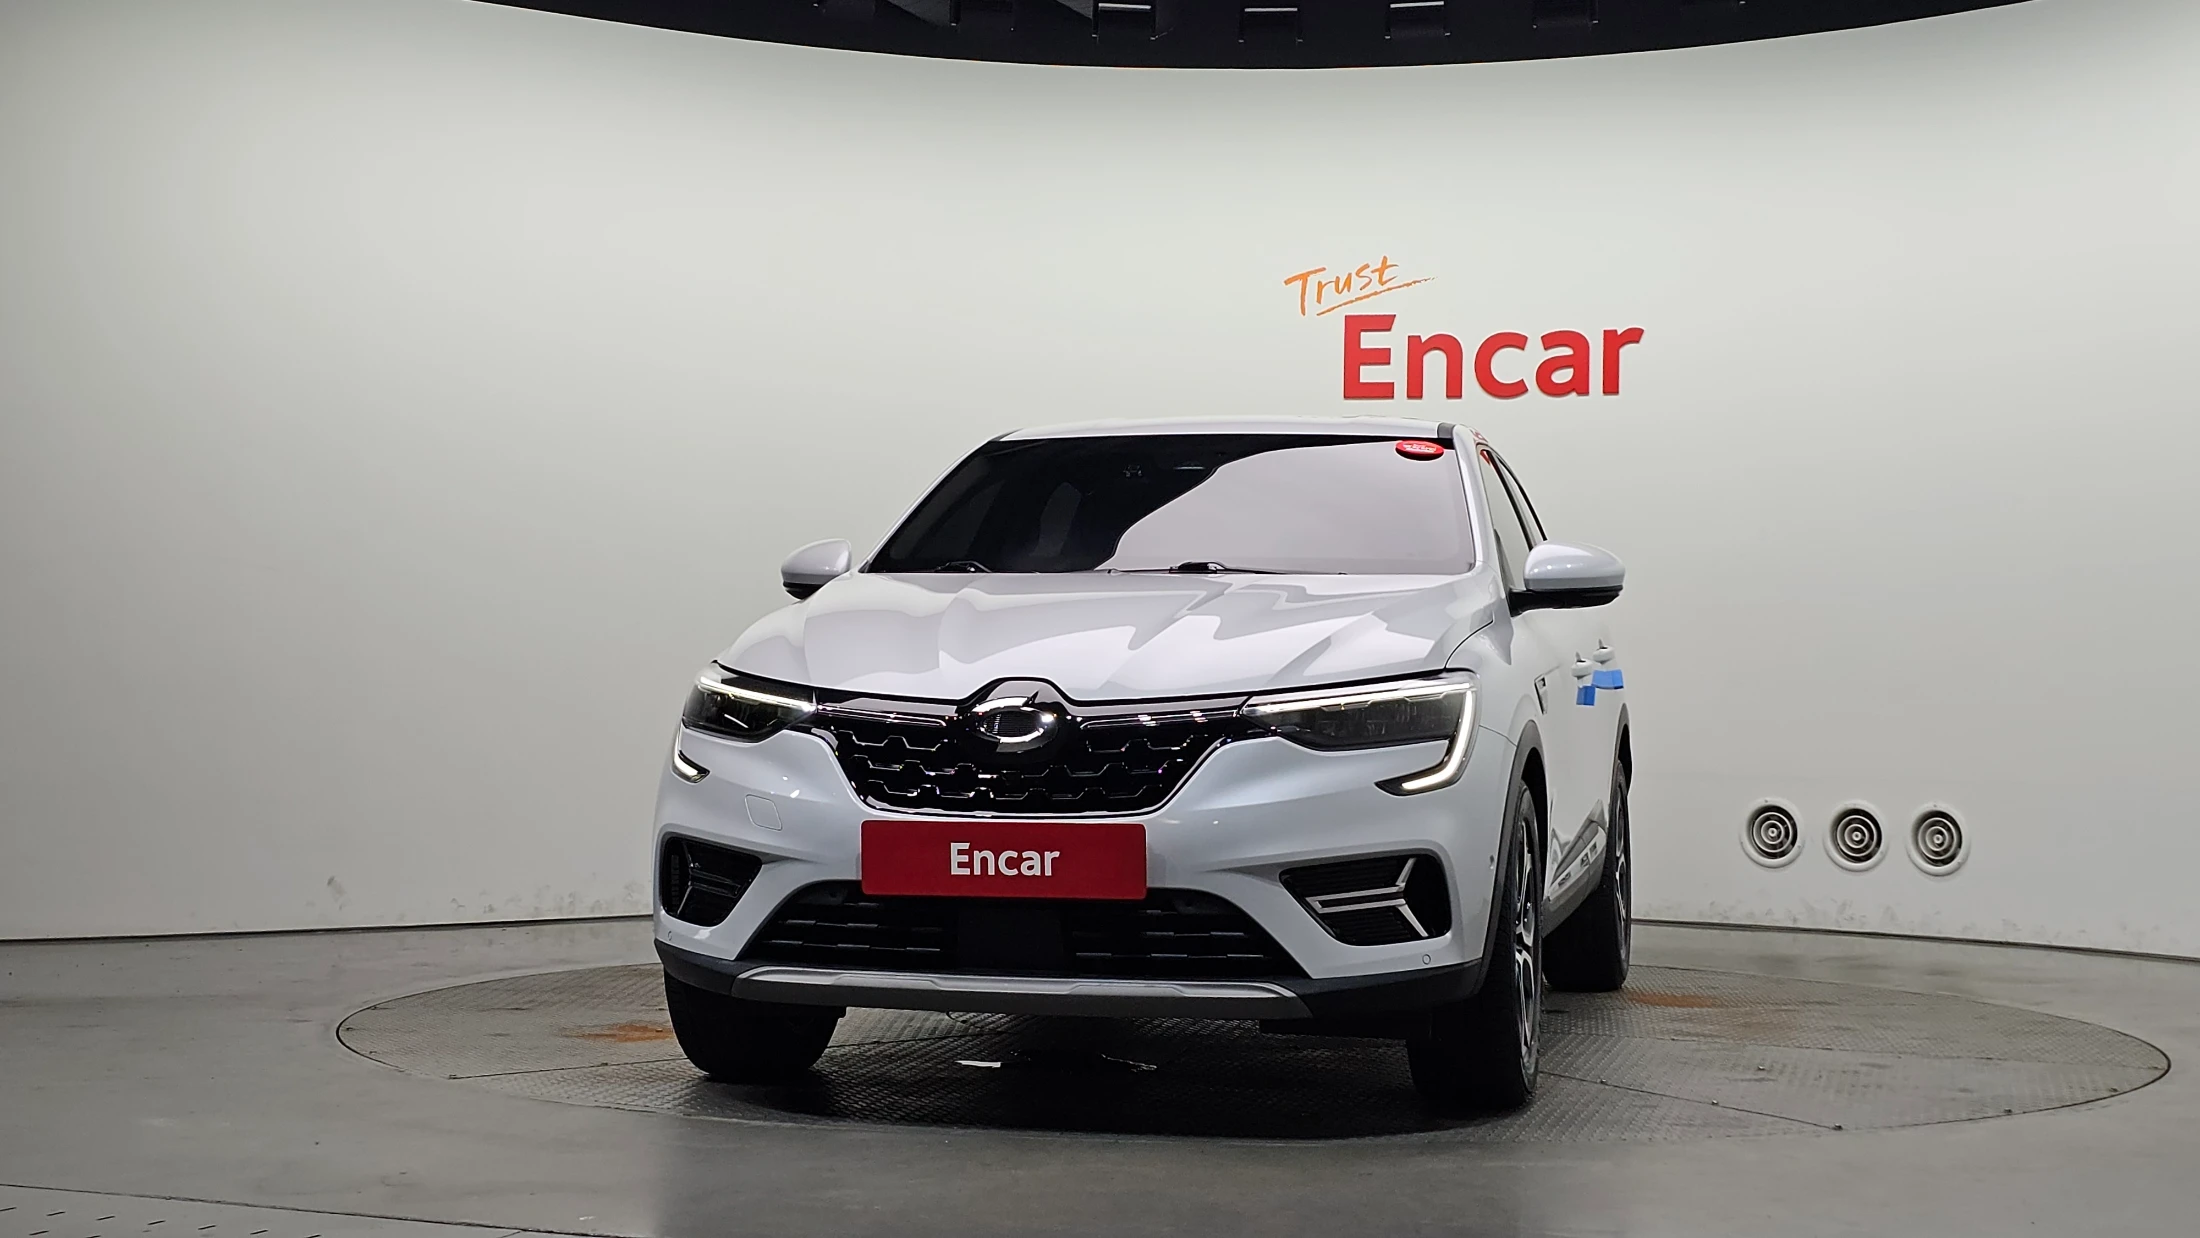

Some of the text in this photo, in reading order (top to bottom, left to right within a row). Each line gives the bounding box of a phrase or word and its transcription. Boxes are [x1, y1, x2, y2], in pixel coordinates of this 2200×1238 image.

[1283, 255, 1399, 317] Trust
[1343, 314, 1645, 399] Encar
[950, 842, 1061, 877] Encar
